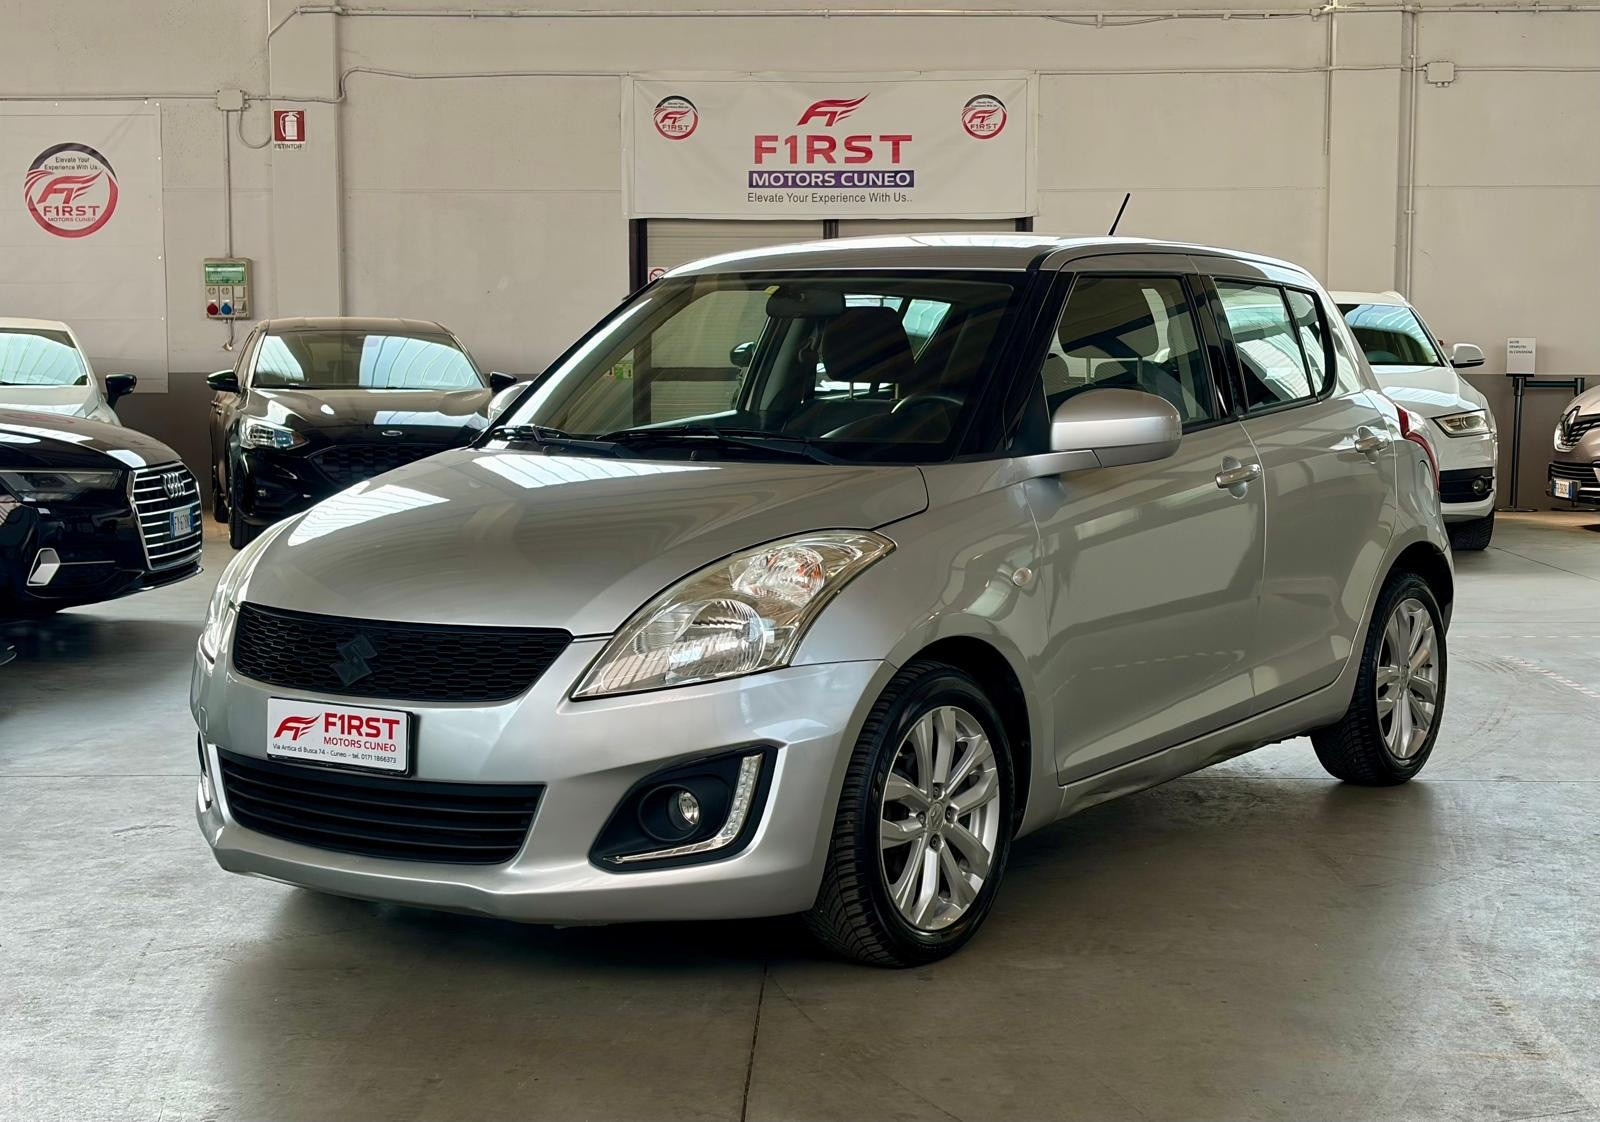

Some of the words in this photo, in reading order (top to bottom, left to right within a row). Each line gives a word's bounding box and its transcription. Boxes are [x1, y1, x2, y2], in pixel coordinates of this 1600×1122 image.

[754, 135, 912, 164] F1RST
[752, 172, 835, 187] MOTORS
[840, 172, 911, 187] CUNEO
[747, 192, 784, 203] Elevate
[786, 192, 808, 203] Your
[811, 192, 866, 204] Experience
[868, 191, 891, 203] With
[43, 205, 100, 216] F1RST
[324, 712, 400, 740] F1RST
[281, 744, 297, 752] Antica
[303, 746, 318, 754] Busca
[330, 750, 348, 758] Cuneo
[323, 736, 362, 749] MOTORS
[363, 741, 397, 752] CUNEO
